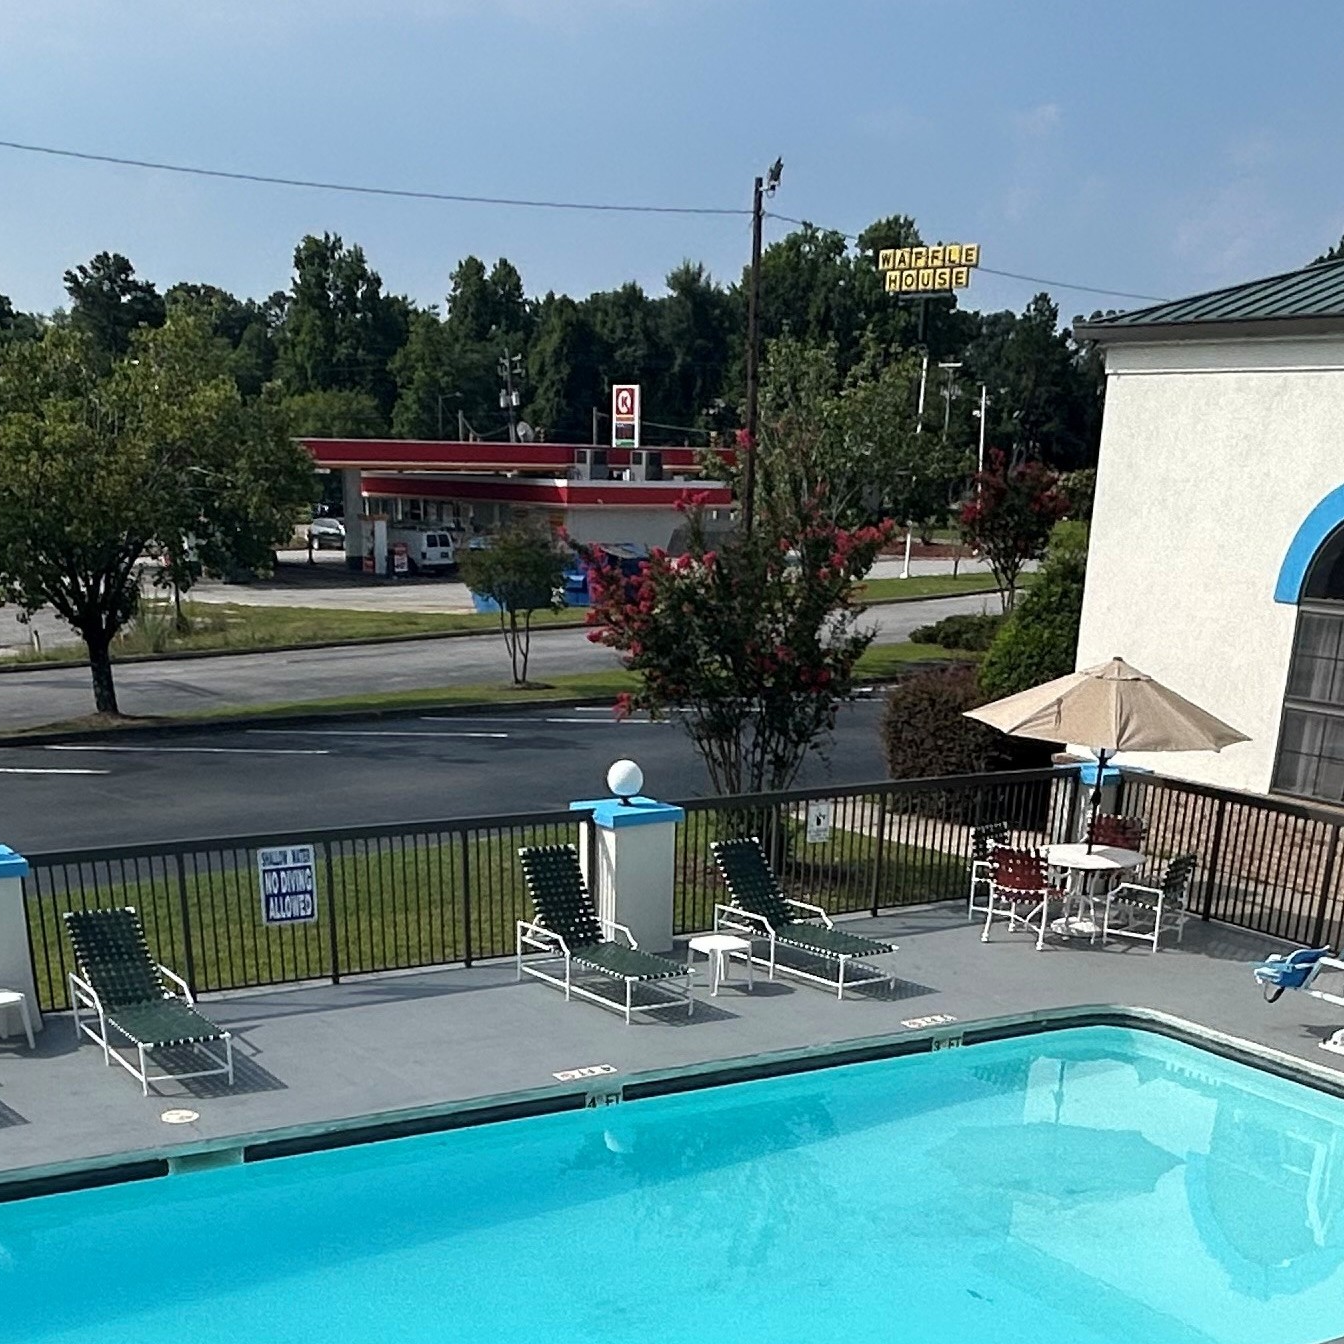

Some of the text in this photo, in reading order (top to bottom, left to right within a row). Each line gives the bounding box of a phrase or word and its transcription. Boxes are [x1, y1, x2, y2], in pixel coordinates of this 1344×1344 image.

[881, 246, 977, 269] WAFFLE
[888, 270, 964, 290] HOUSE
[264, 868, 313, 895] NO DIVING
[269, 894, 312, 919] ALLOWED
[587, 1092, 621, 1108] 4 FT
